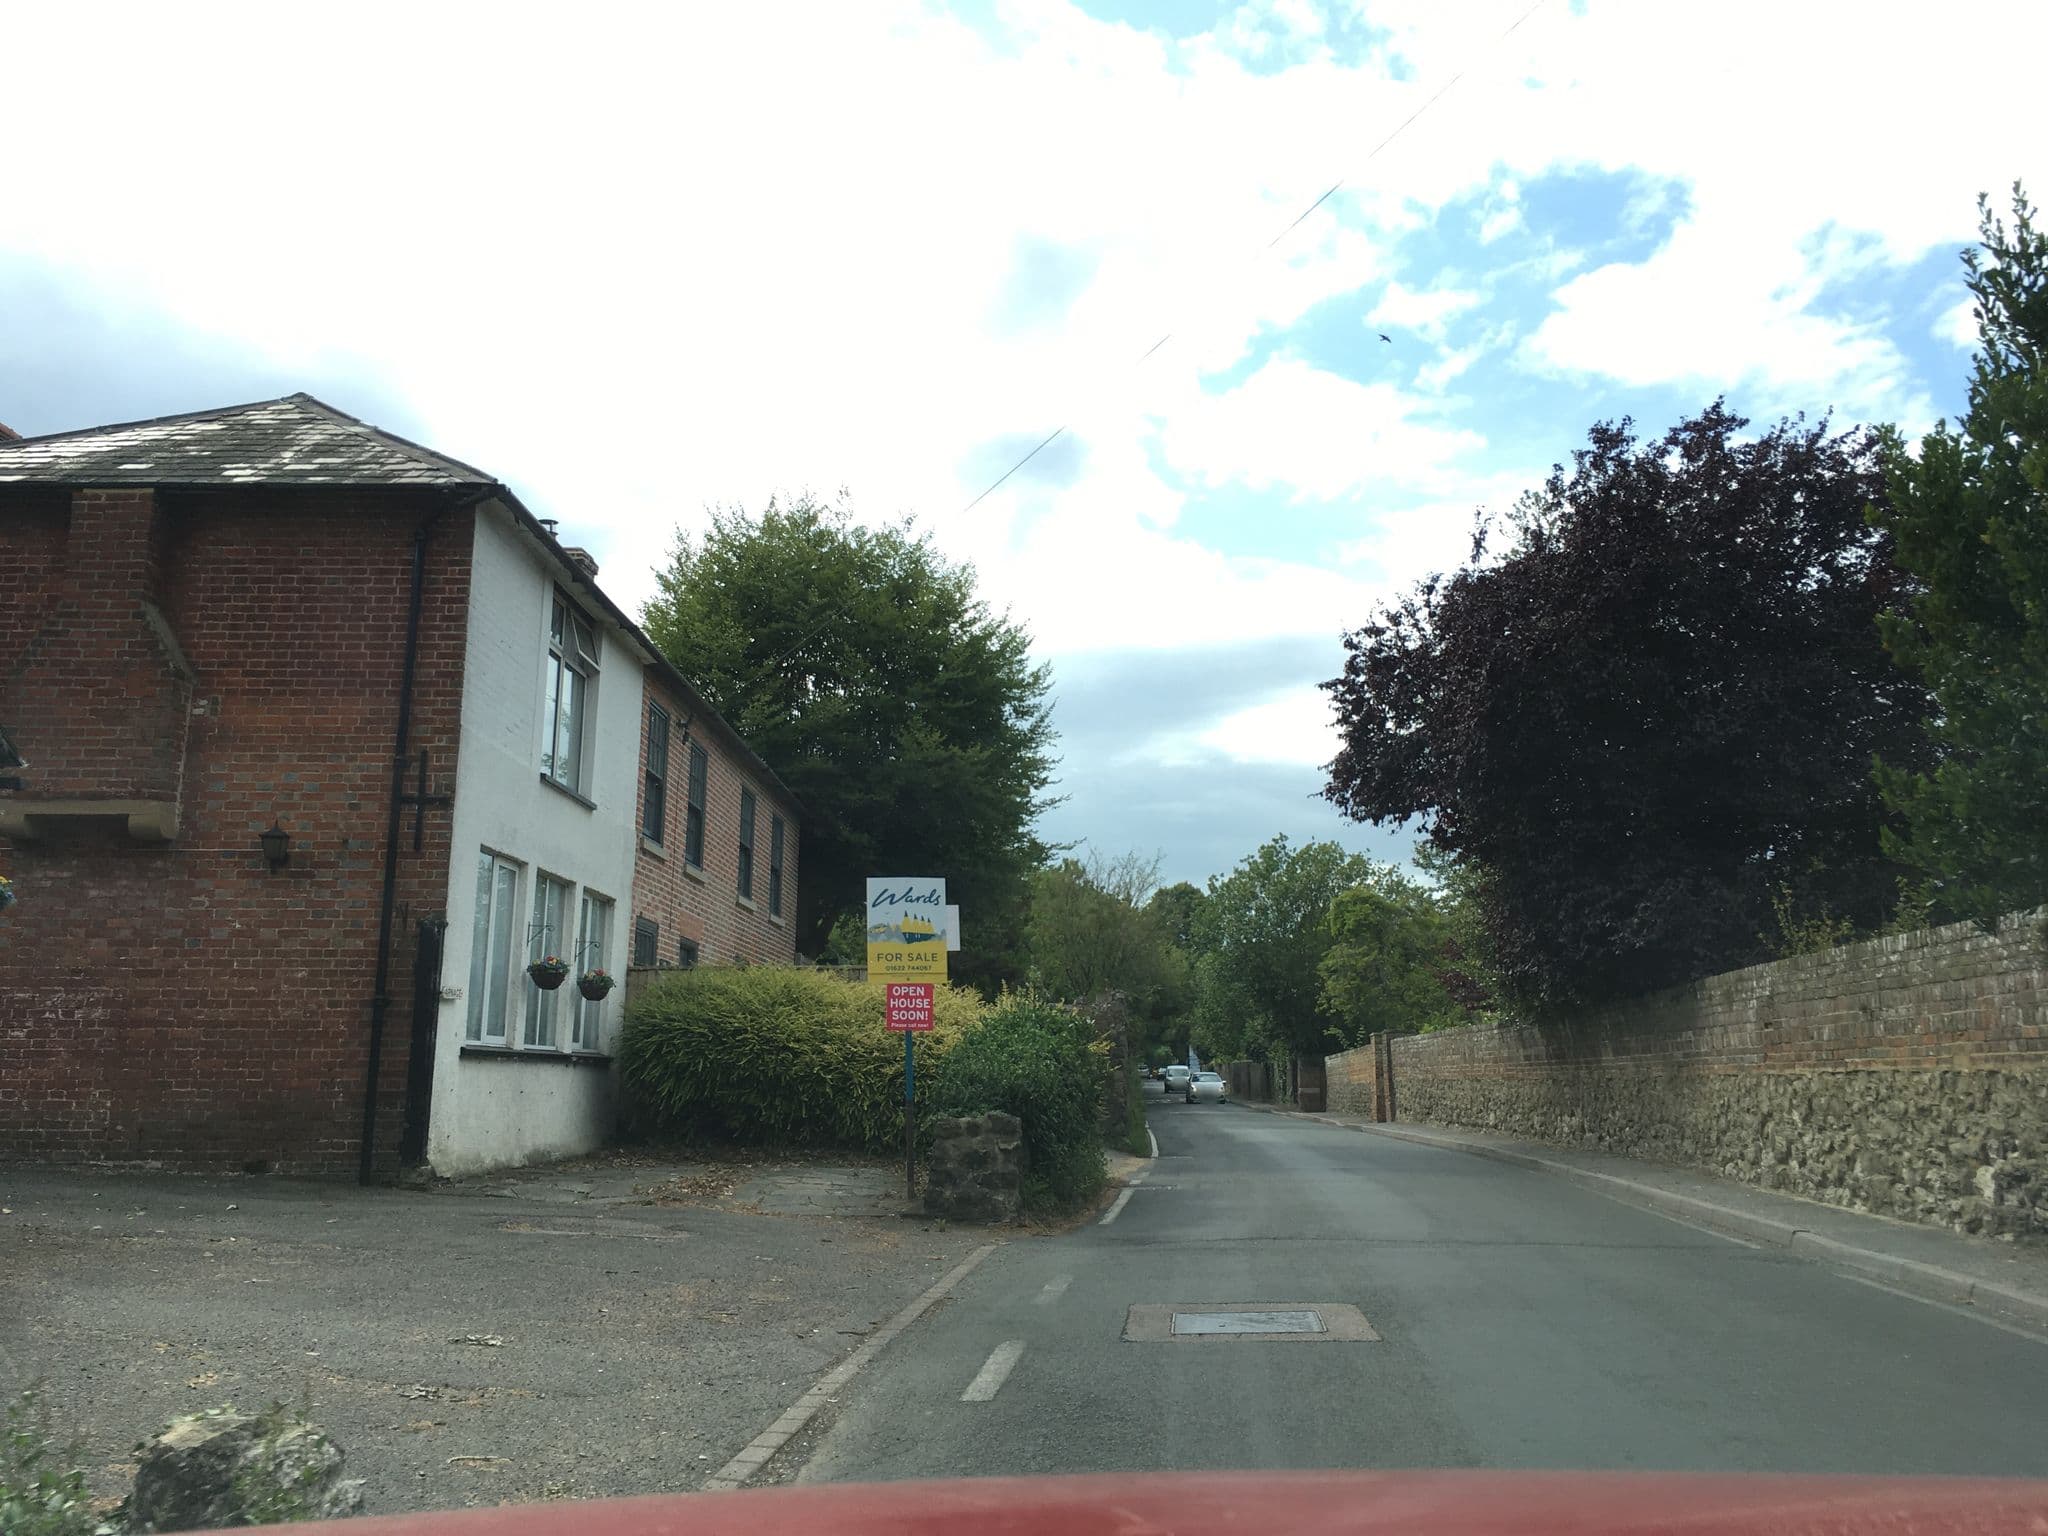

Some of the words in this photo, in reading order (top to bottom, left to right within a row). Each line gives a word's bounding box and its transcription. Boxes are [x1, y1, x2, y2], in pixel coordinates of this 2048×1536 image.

[872, 886, 941, 908] Wards
[877, 953, 903, 962] FOR
[908, 952, 938, 962] SALE
[893, 986, 924, 997] OPEN
[890, 998, 930, 1008] HOUSE
[892, 1010, 928, 1021] SOON!
